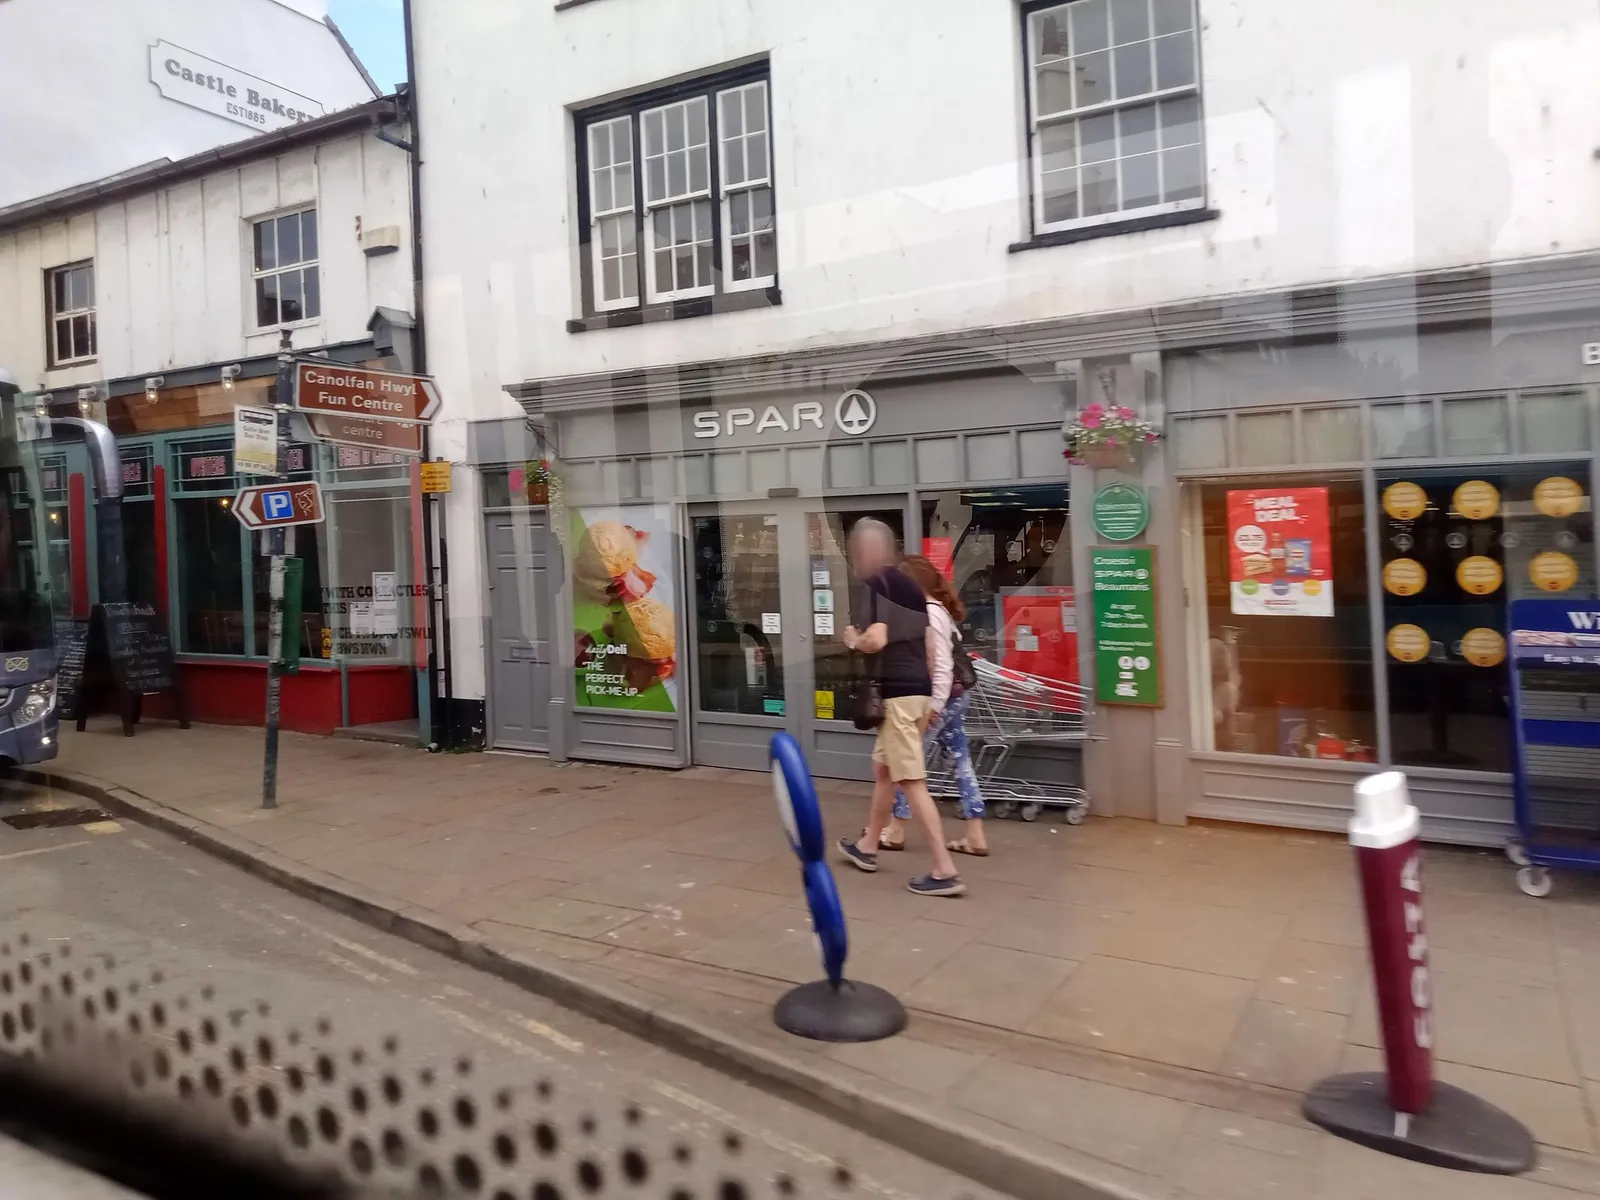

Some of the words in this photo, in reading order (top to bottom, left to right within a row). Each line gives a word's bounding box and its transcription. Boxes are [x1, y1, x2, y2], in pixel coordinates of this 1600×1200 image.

[165, 59, 237, 98] Castle
[304, 371, 374, 390] Canolfan
[380, 380, 417, 396] Hwyl
[318, 391, 346, 406] Fun
[351, 395, 403, 411] Centre
[693, 401, 824, 438] SPAR
[342, 425, 383, 439] centre
[269, 495, 289, 516] P
[584, 661, 604, 671] THE
[585, 673, 625, 683] PERFECT
